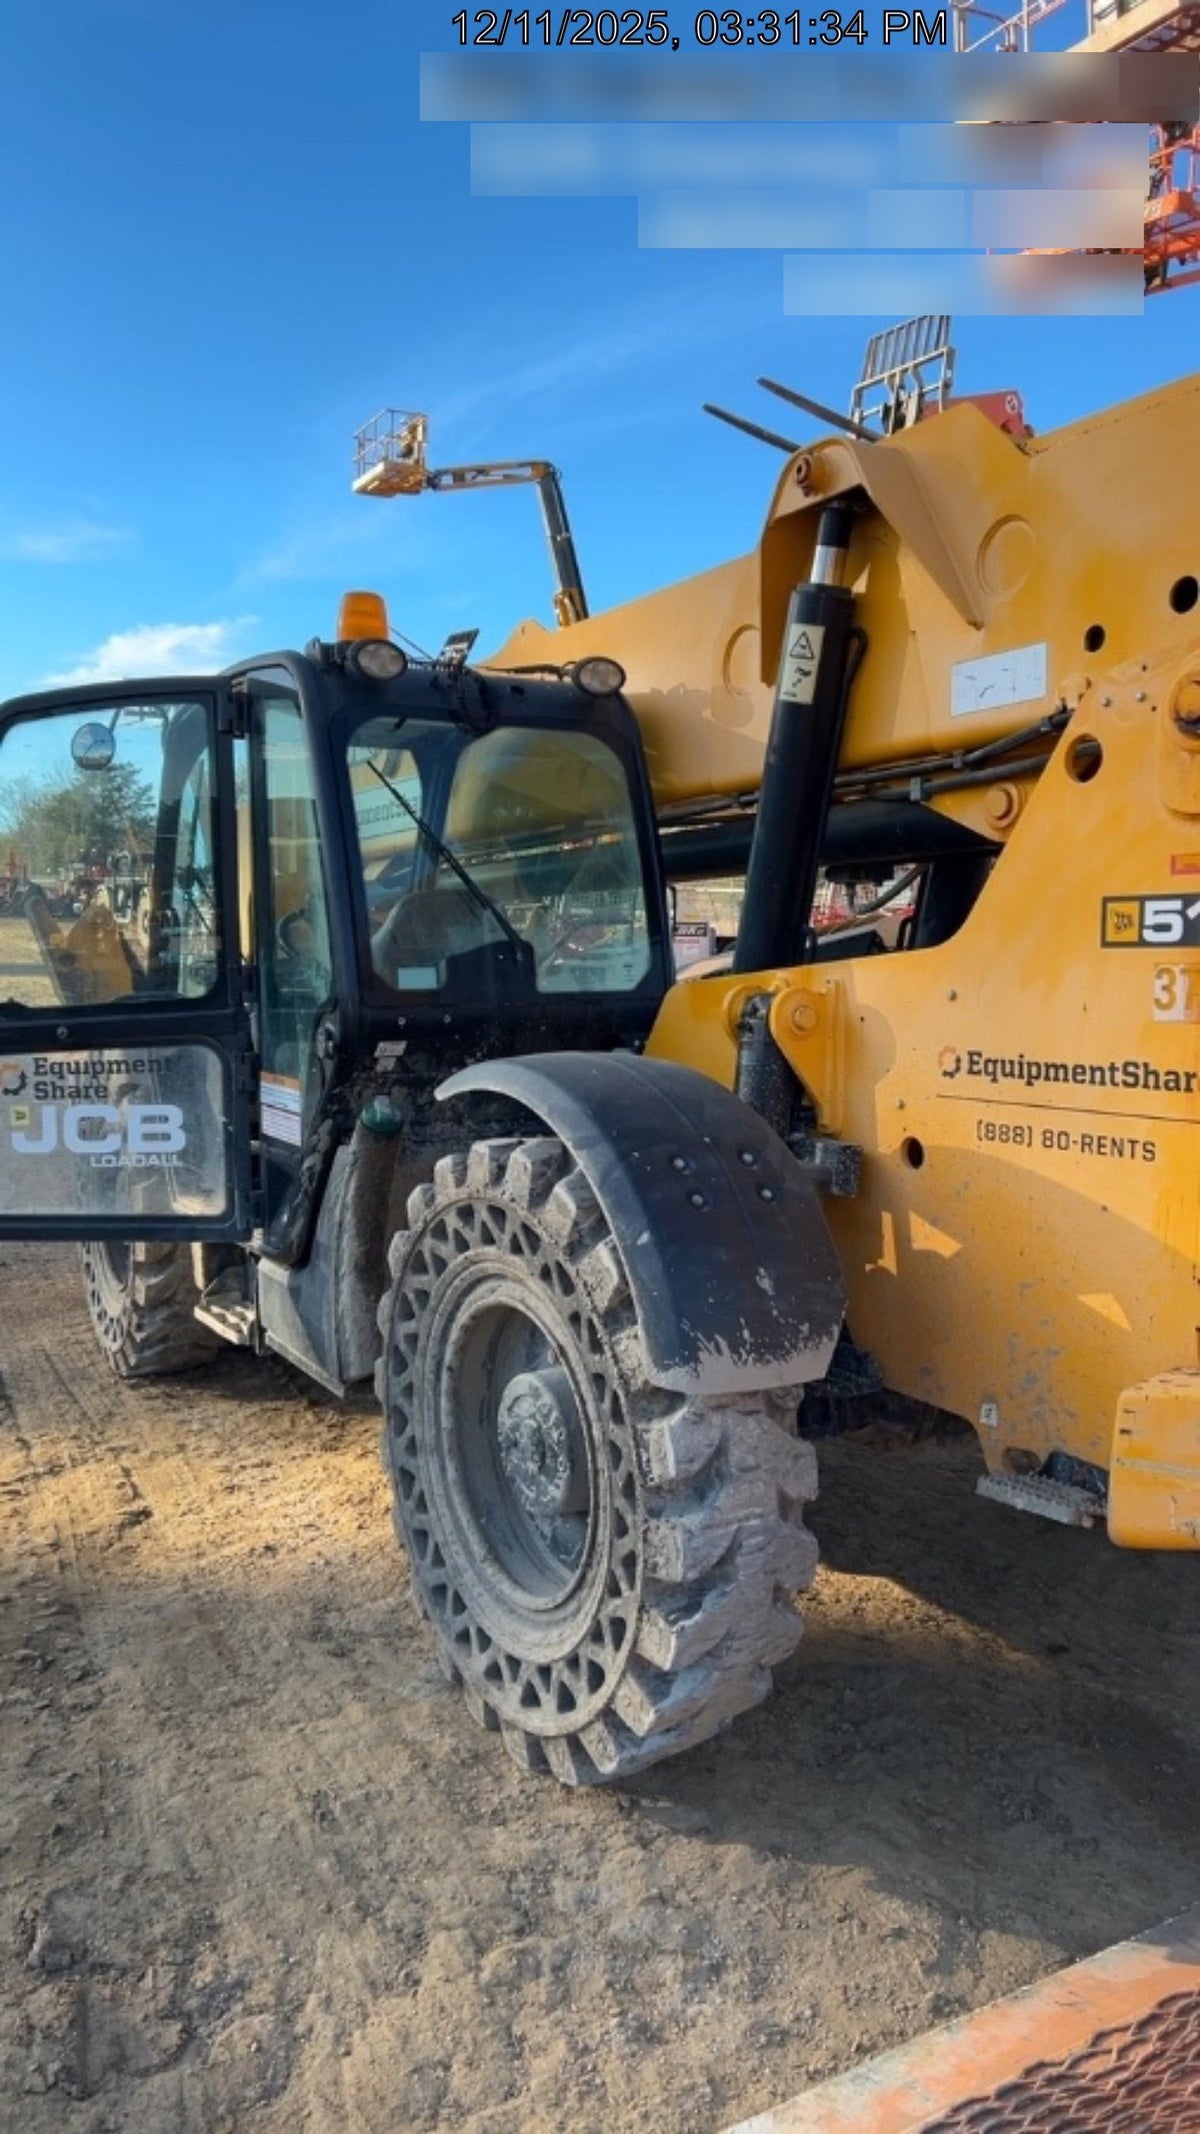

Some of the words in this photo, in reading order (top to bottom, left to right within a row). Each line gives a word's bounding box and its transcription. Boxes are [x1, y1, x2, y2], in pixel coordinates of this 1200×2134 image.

[33, 1057, 174, 1079] Equipment
[967, 1050, 1200, 1093] EquipmentShar
[34, 1081, 108, 1101] Share
[11, 1104, 186, 1154] JCB
[1041, 1129, 1157, 1162] 80-RENTS
[90, 1154, 183, 1168] LOADALL
